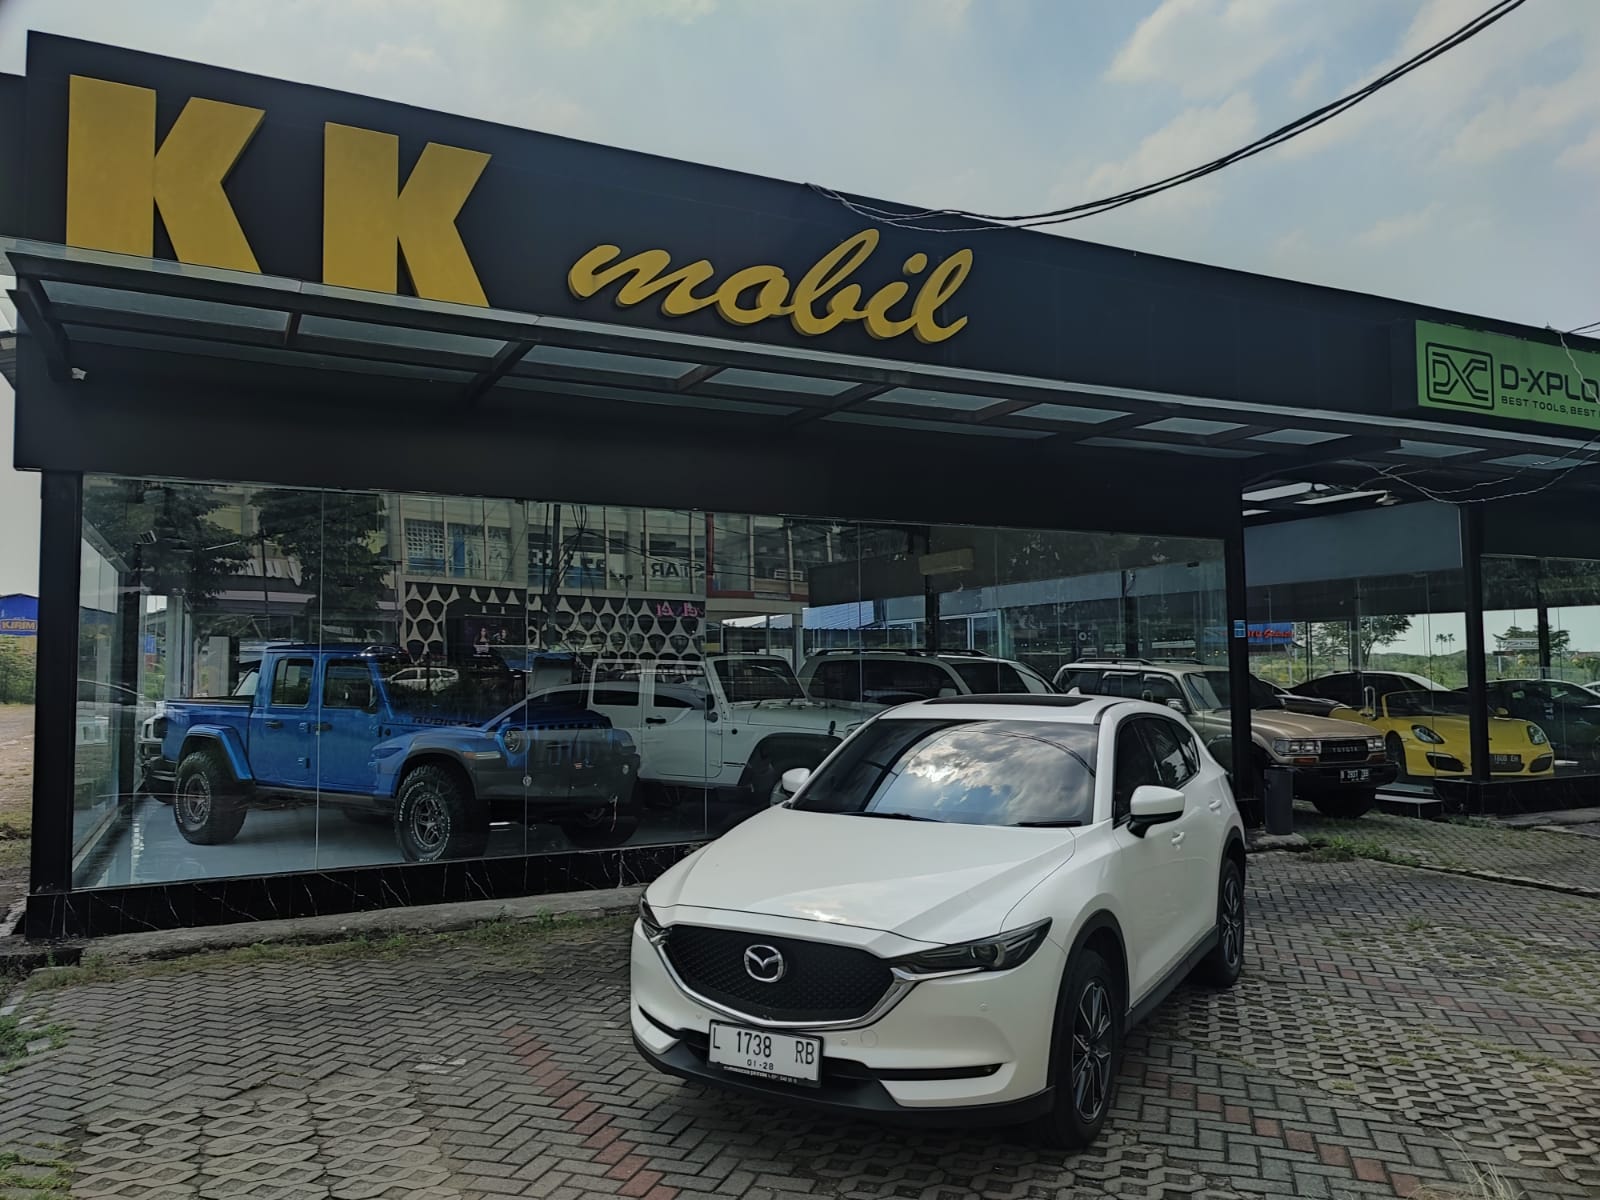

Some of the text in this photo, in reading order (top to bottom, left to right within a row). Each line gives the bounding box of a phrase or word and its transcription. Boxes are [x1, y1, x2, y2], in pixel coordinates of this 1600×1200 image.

[567, 228, 973, 344] mobil
[1501, 395, 1597, 417] BEST TOOLS, BEST
[712, 1027, 815, 1065] L 1738 RB
[746, 1058, 774, 1071] 01-28
